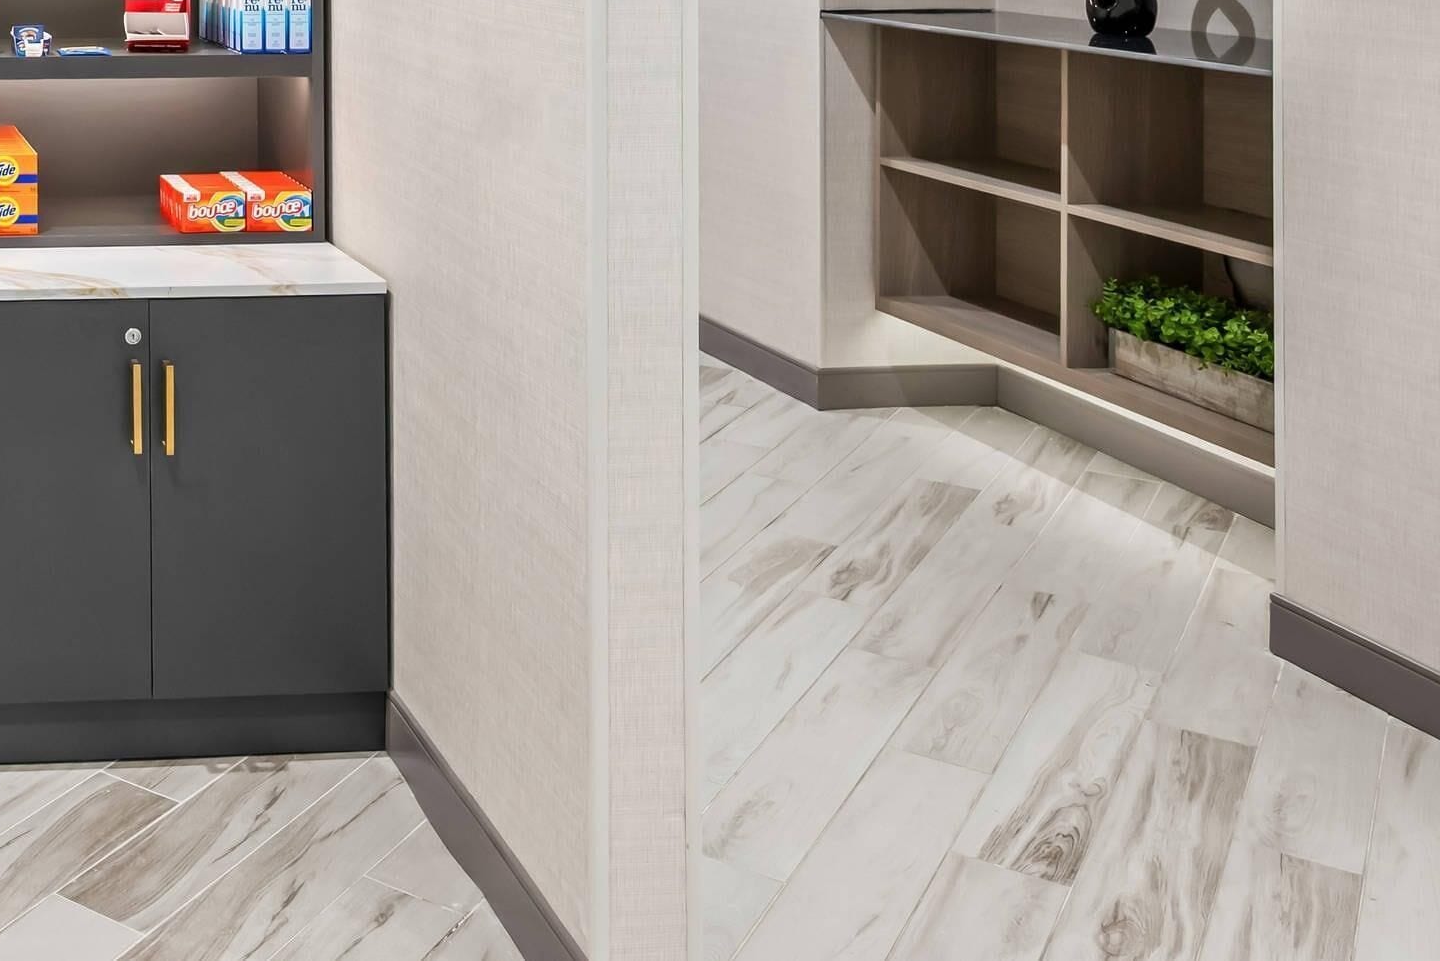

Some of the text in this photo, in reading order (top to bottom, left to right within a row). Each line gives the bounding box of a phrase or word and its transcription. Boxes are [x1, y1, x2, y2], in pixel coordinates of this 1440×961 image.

[291, 3, 306, 11] nu
[188, 200, 237, 219] bounce
[253, 199, 303, 219] bounce
